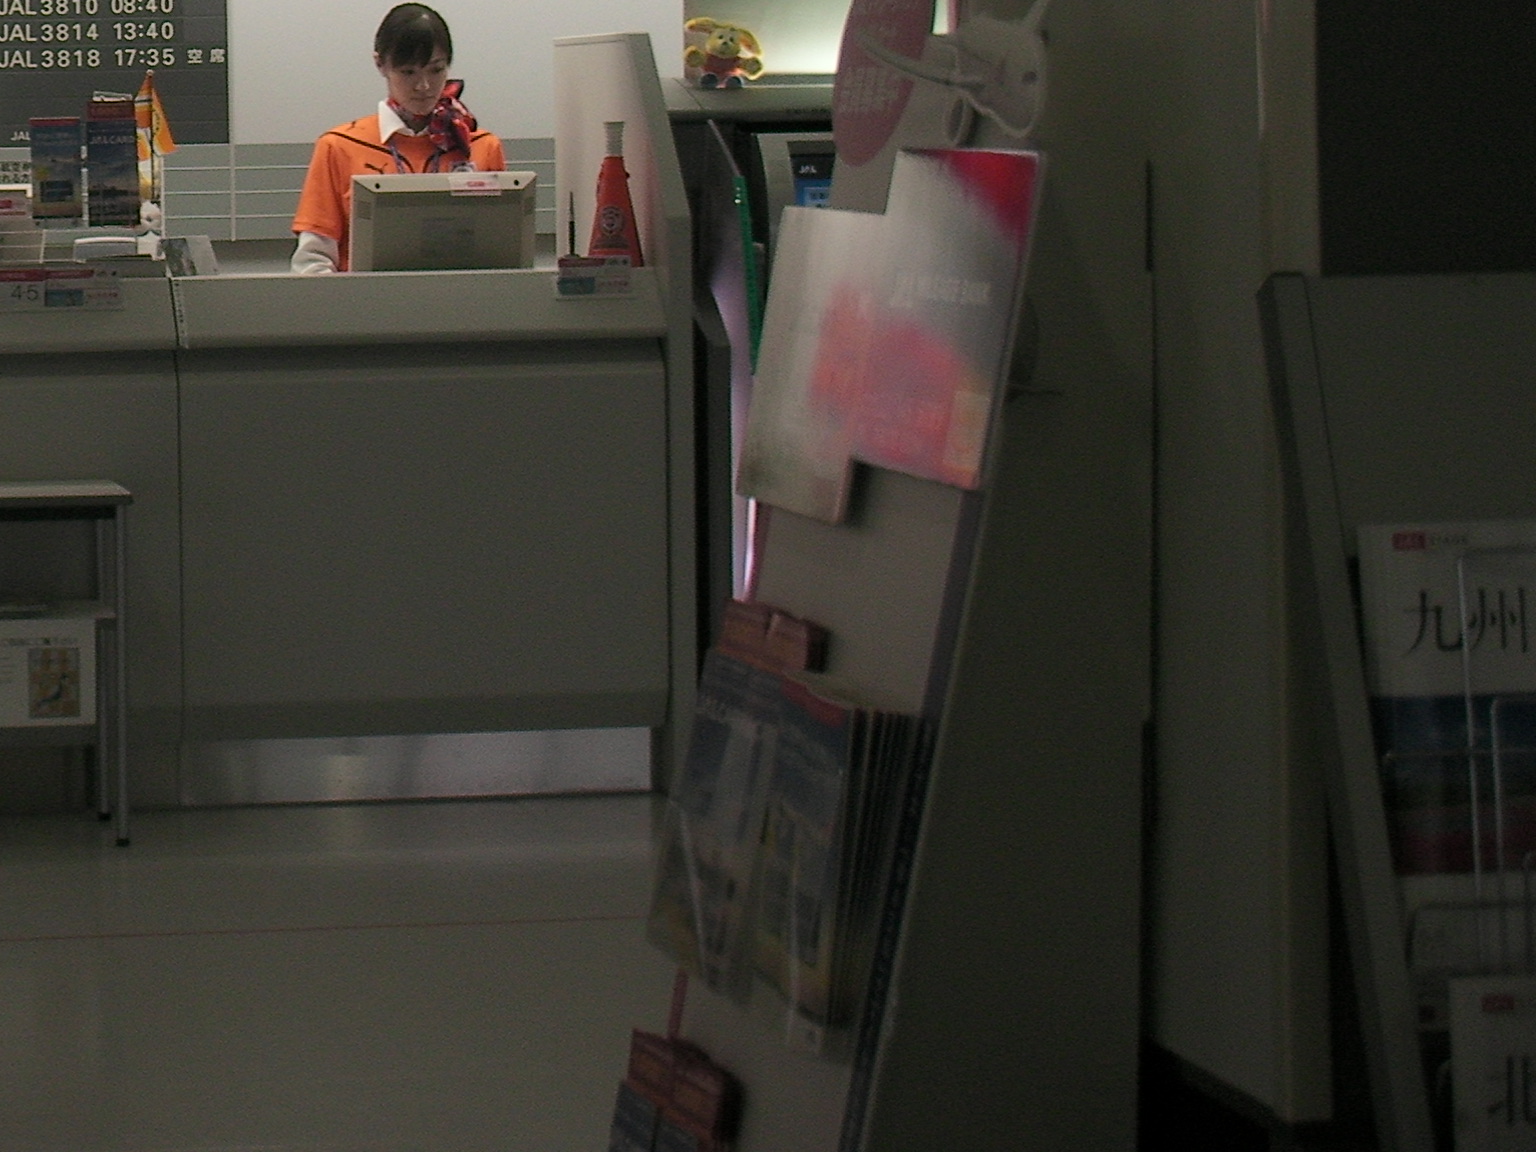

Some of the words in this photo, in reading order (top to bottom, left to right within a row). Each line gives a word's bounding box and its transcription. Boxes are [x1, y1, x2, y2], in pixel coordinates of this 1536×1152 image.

[113, 21, 174, 41] 13:40
[114, 48, 176, 67] 17:35
[1402, 587, 1529, 657] 九州
